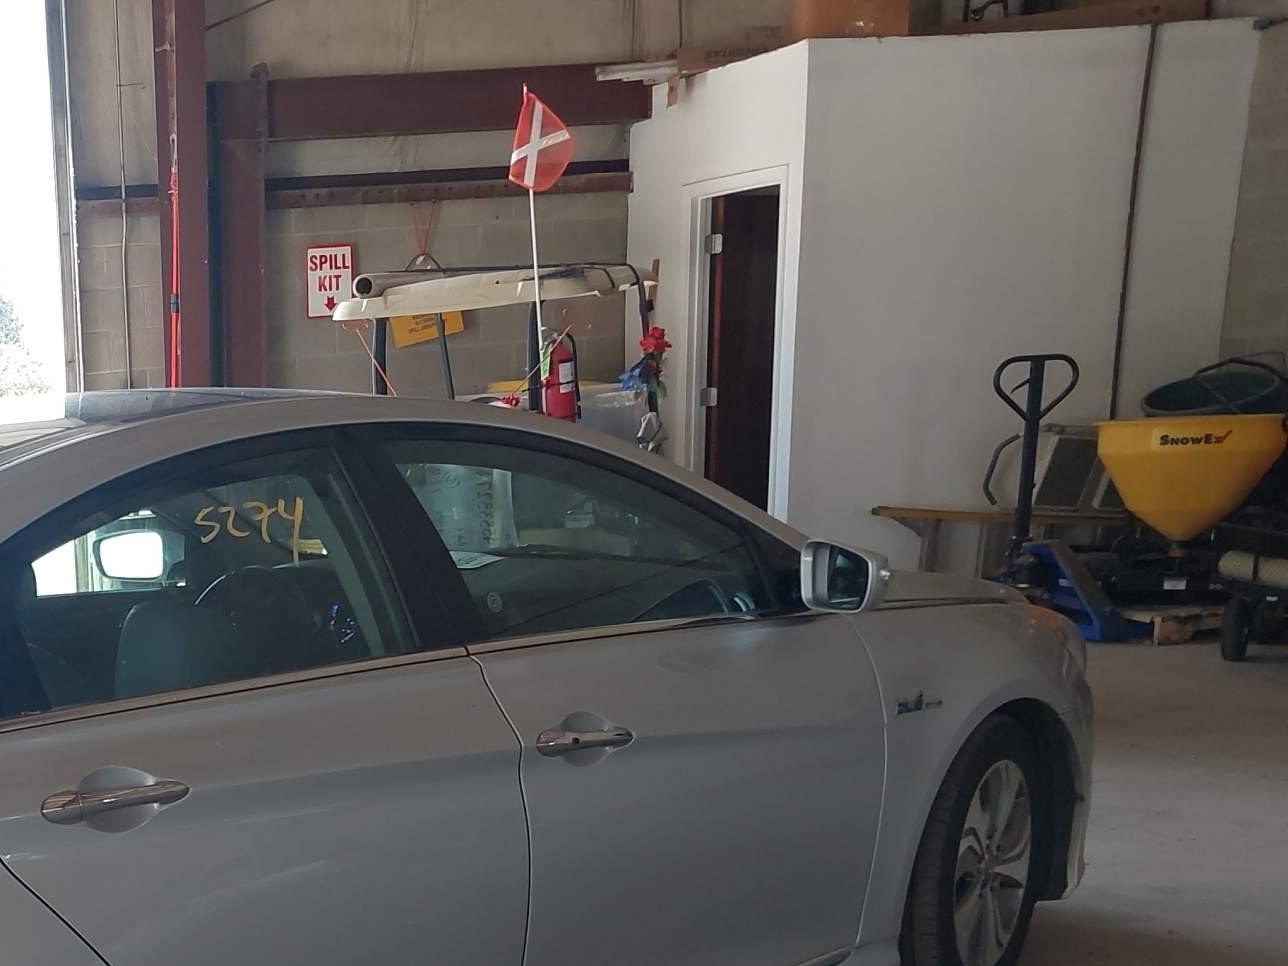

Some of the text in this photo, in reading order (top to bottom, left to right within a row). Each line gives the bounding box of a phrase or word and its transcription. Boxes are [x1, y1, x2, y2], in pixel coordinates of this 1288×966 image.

[309, 253, 350, 272] SPILL
[318, 274, 342, 292] KIT
[194, 496, 304, 568] 5274
